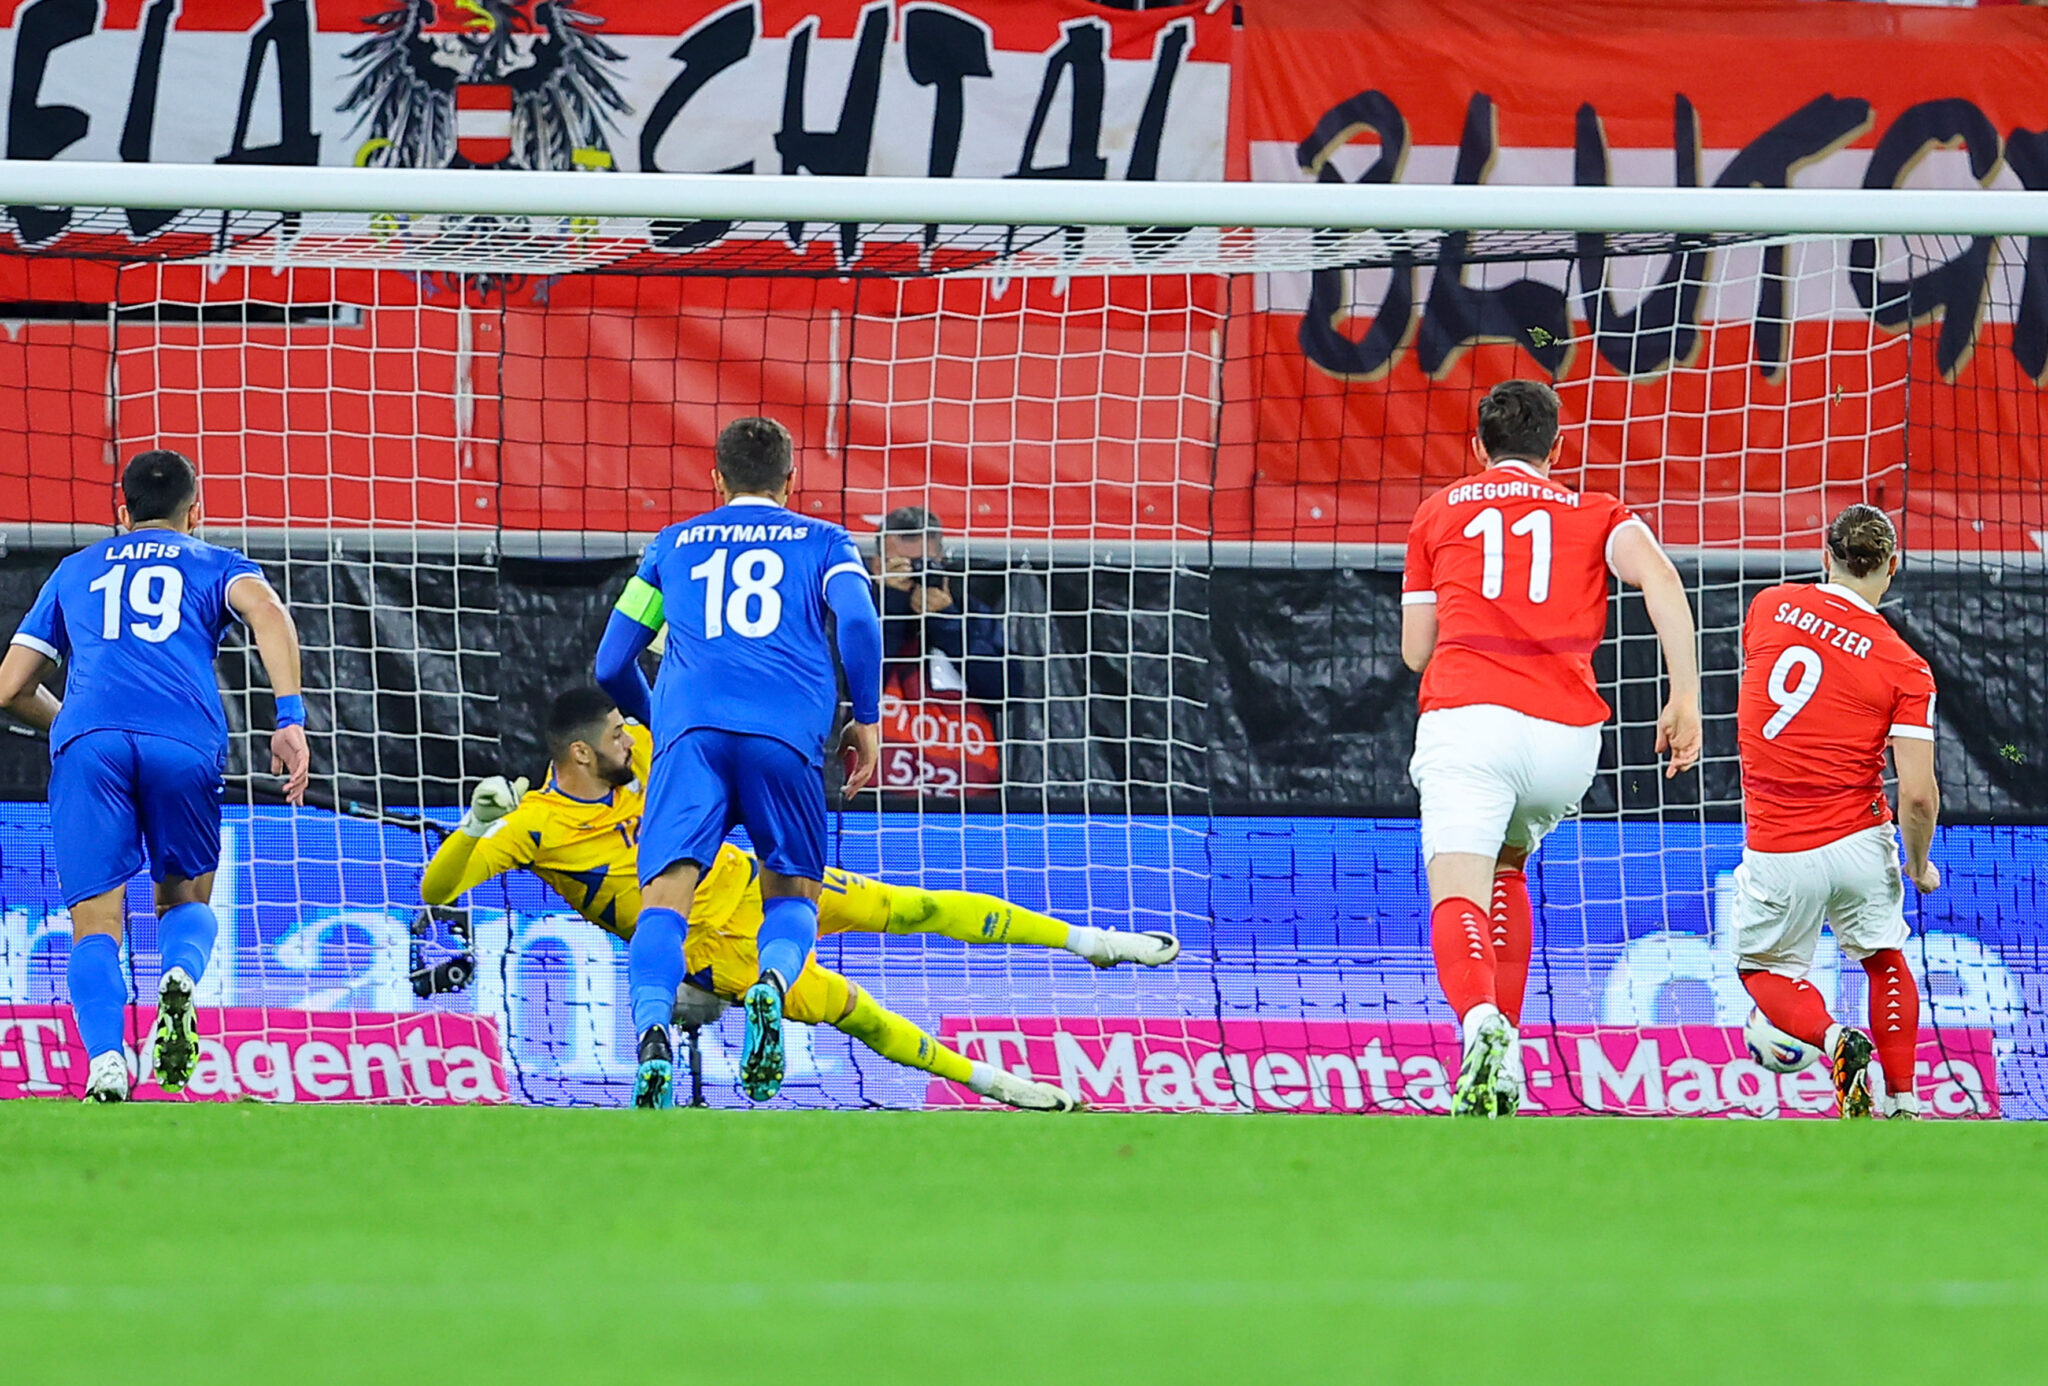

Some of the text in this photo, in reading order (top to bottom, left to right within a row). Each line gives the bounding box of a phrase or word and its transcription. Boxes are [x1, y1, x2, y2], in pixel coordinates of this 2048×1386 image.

[1447, 481, 1580, 509] GREGORITSCH
[105, 541, 181, 561] LAIFIS
[675, 523, 809, 548] ARTYMATAS
[1463, 507, 1552, 604] 11
[89, 564, 184, 643] 19
[690, 548, 785, 640] 18
[1774, 602, 1873, 659] SABITZER
[1762, 645, 1823, 740] 9
[886, 750, 960, 798] 522
[123, 1020, 498, 1103] agenta
[1053, 1031, 1452, 1113] Magenta
